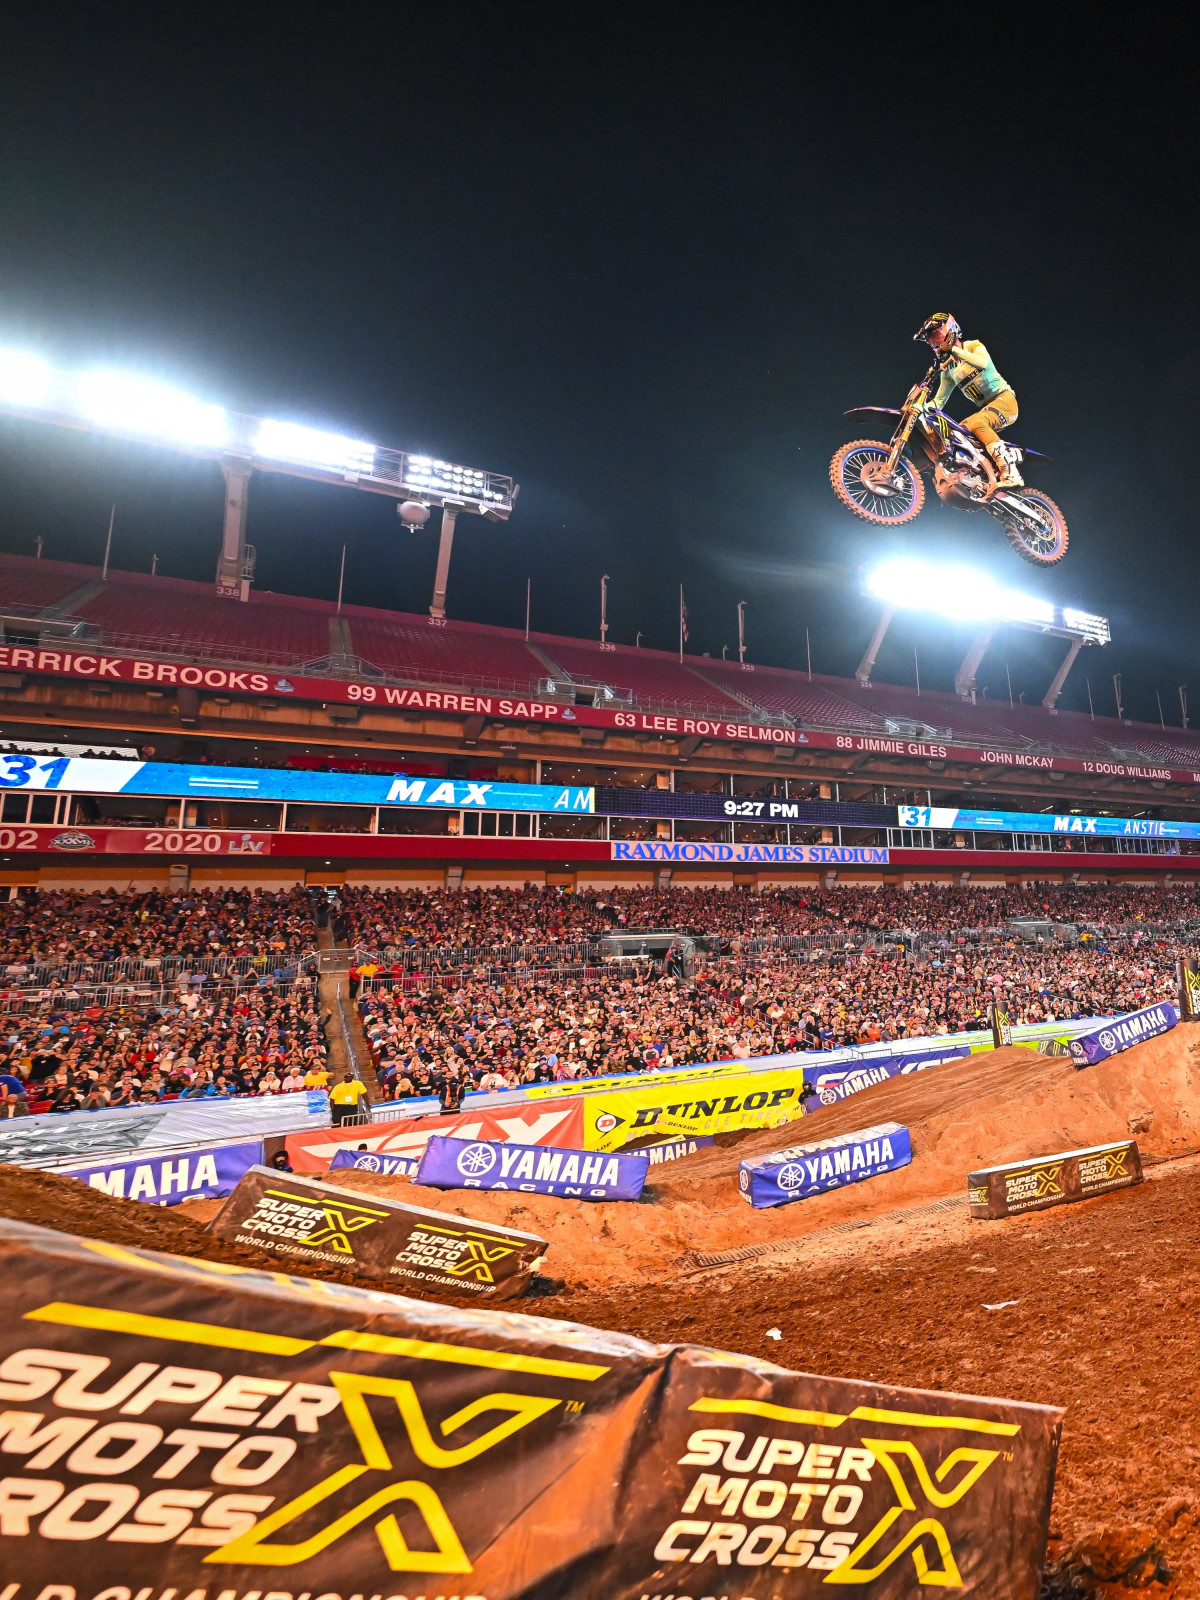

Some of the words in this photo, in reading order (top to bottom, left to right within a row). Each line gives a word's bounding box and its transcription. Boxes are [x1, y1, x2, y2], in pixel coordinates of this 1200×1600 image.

[216, 586, 240, 597] 338
[428, 618, 448, 627] 337
[132, 661, 269, 692] BROOKS
[347, 684, 377, 702] 99
[384, 688, 492, 713] WARREN
[499, 700, 558, 719] SAPP
[614, 712, 636, 726] 63
[642, 715, 678, 731] LEE
[683, 719, 721, 736] ROY
[726, 724, 796, 743] SELMON
[836, 736, 853, 748] 88
[857, 737, 904, 754] JIMMIE
[907, 742, 947, 758] GILES
[980, 750, 1013, 764] JOHN
[1015, 754, 1054, 768] MCKAY
[1082, 762, 1094, 772] 12
[1096, 763, 1125, 776] DOUG
[1126, 766, 1171, 780] WILLIAMS
[387, 779, 493, 805] MAX
[724, 800, 764, 817] 9:27
[769, 802, 799, 818] PM
[901, 806, 932, 827] 31
[1053, 816, 1097, 833] MAX
[1123, 821, 1166, 836] ANSTIE
[144, 833, 222, 852] 2020
[614, 842, 734, 862] RAYMOND
[735, 846, 804, 862] JAMES
[808, 848, 889, 864] STADIUM
[1112, 1008, 1168, 1044] YAMAHA
[834, 1066, 891, 1099] YAMAHA
[629, 1087, 795, 1130] DUNLOP
[499, 1147, 620, 1187] YAMAHA
[805, 1137, 895, 1184] YAMAHA
[1078, 1158, 1106, 1171] SUPER
[1081, 1165, 1106, 1177] MOTO
[78, 1154, 220, 1201] MAHA
[464, 1178, 607, 1197] RACING
[787, 1163, 889, 1198] RACING
[1005, 1174, 1038, 1188] SUPER
[1008, 1182, 1037, 1194] MOTO
[1080, 1172, 1108, 1184] CROSS
[1081, 1184, 1099, 1193] WORLD
[1099, 1175, 1133, 1189] CHAMPIONSHIP
[1006, 1188, 1039, 1203] CROSS
[1007, 1203, 1027, 1212] WORLD
[1028, 1193, 1066, 1208] CHAMPIONSHIP
[253, 1209, 316, 1230] MOTO
[255, 1198, 325, 1221] SUPER
[241, 1221, 312, 1241] CROSS
[406, 1231, 470, 1252] SUPER
[234, 1234, 275, 1250] WORLD
[275, 1243, 356, 1266] CHAMPIONSHIP
[405, 1242, 462, 1261] MOTO
[395, 1251, 457, 1271] CROSS
[389, 1266, 426, 1281] WORLD
[425, 1273, 497, 1293] CHAMPIONSHIP
[0, 1347, 342, 1433] SUPER
[0, 1410, 298, 1487] MOTO
[677, 1428, 877, 1482] SUPER
[681, 1474, 865, 1526] MOTO
[653, 1519, 860, 1570] CROSS
